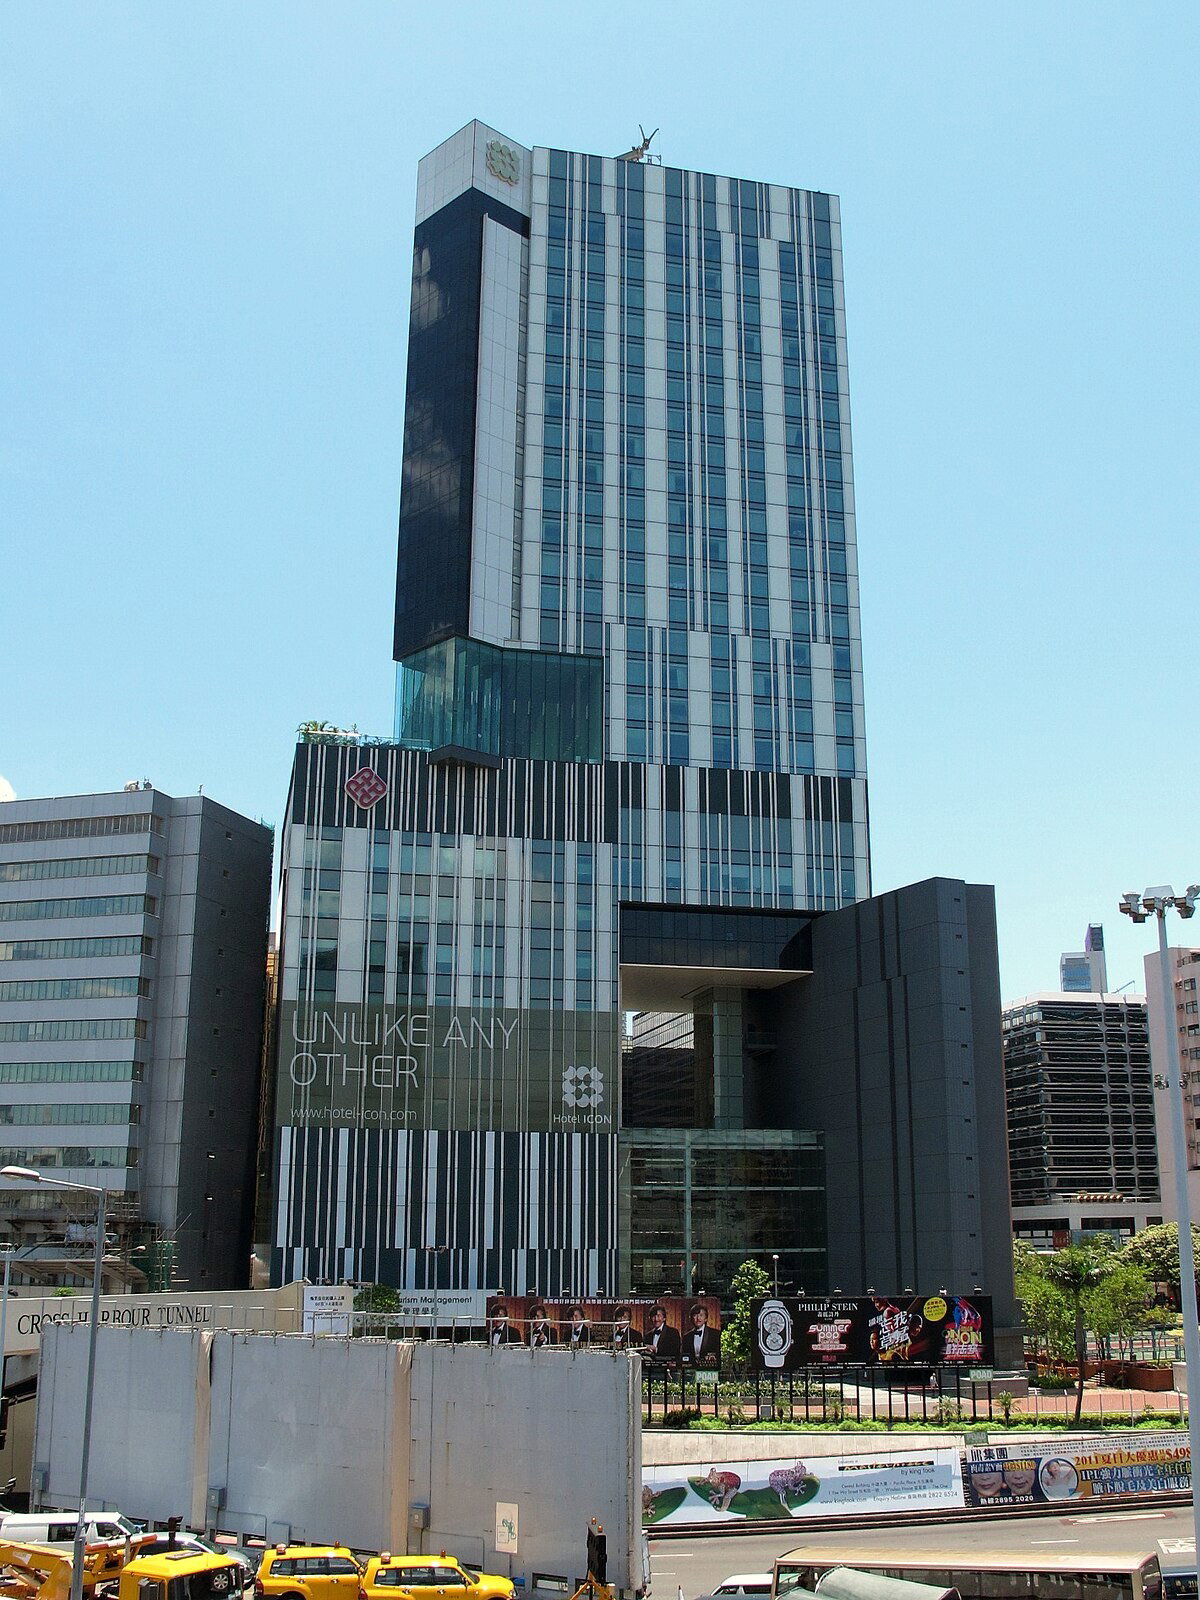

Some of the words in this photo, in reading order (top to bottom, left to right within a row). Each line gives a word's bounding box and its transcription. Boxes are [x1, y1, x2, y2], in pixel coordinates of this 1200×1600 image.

[292, 1010, 431, 1048] UNLIKE
[443, 1016, 519, 1050] ANY
[289, 1052, 419, 1089] OTHER
[290, 1106, 417, 1121] www.hotel-icon.com
[553, 1114, 580, 1124] Hotel
[583, 1114, 612, 1125] ICON
[798, 1303, 830, 1312] PHILIP
[831, 1302, 859, 1311] STEIN
[157, 1305, 210, 1325] TUNNEL
[970, 1370, 992, 1379] POAD
